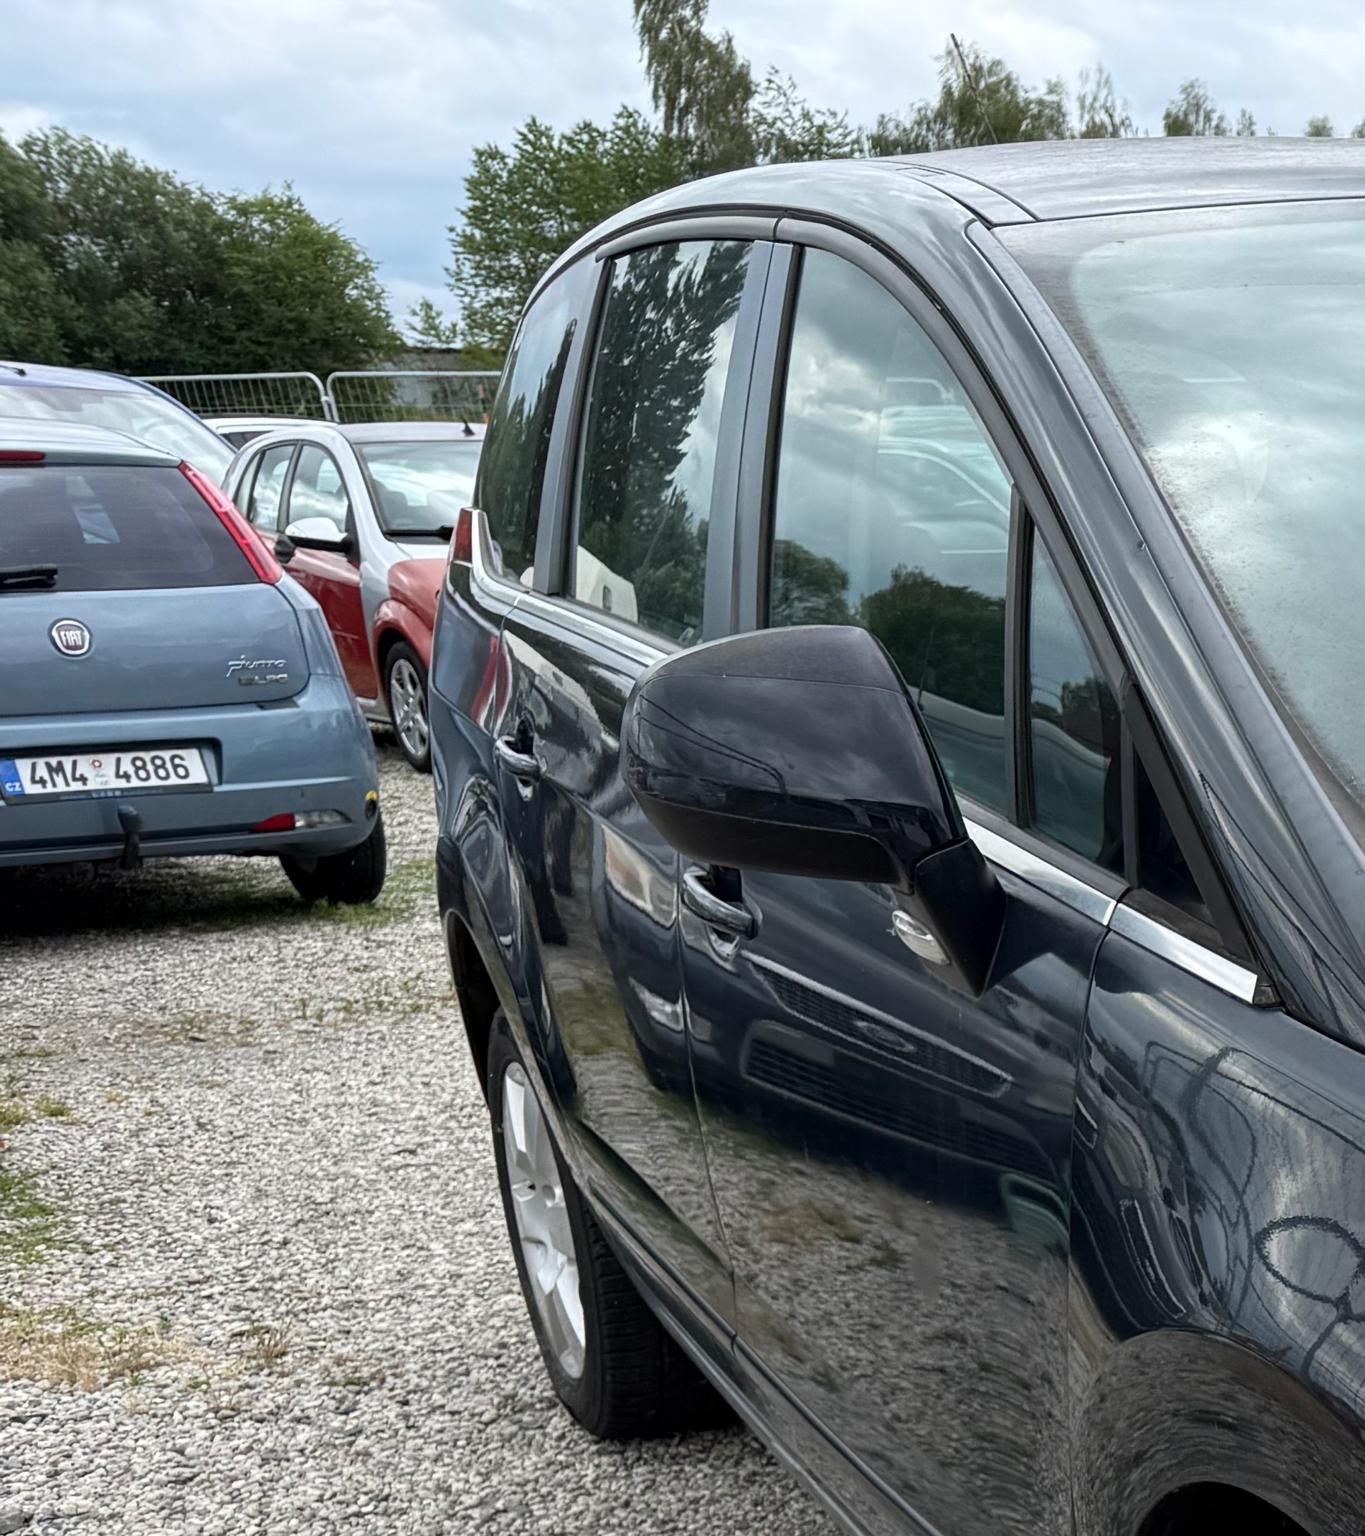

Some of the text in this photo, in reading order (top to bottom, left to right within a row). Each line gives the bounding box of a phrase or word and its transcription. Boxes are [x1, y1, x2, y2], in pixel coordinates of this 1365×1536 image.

[60, 630, 83, 647] FIAT
[30, 754, 190, 789] 4M4 4886
[5, 782, 22, 793] CZ
